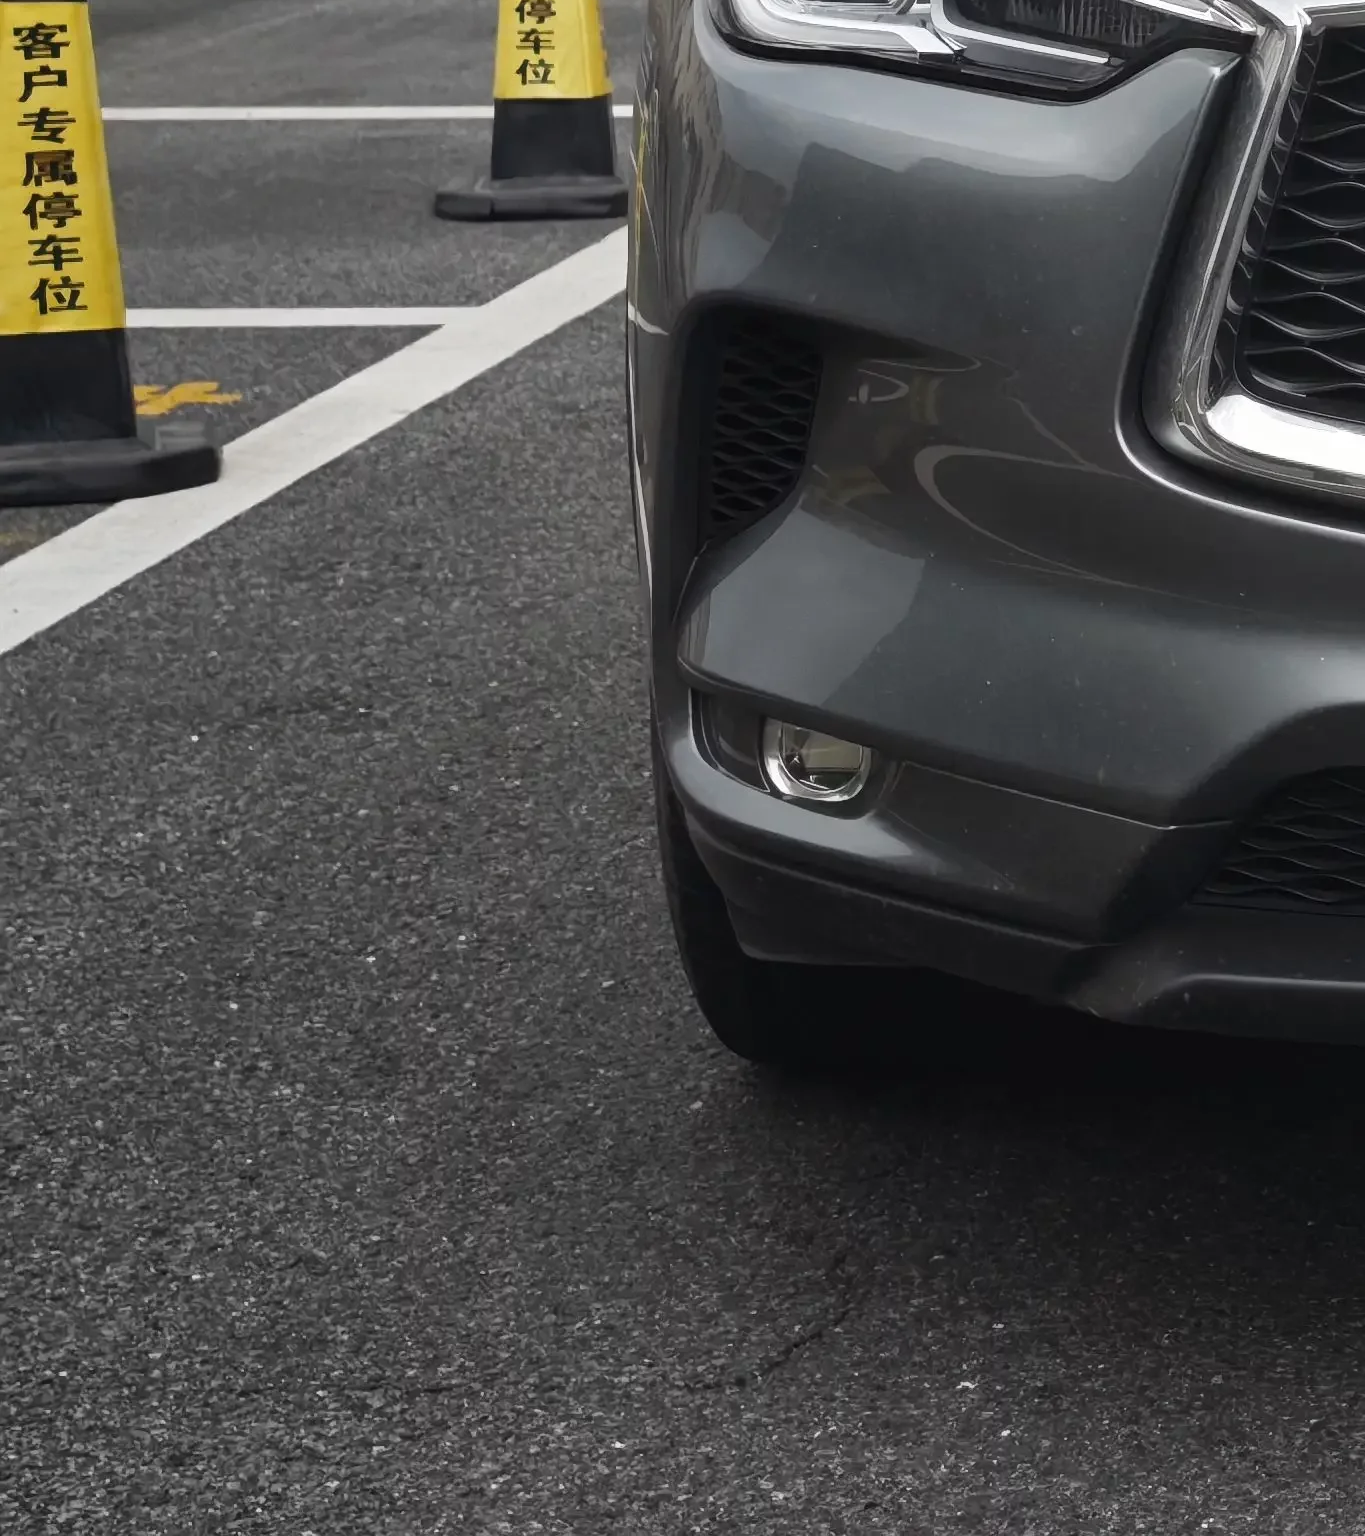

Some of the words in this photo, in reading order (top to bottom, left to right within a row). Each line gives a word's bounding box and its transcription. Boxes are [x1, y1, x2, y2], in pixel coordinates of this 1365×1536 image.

[12, 22, 88, 315] 客户专属停车位
